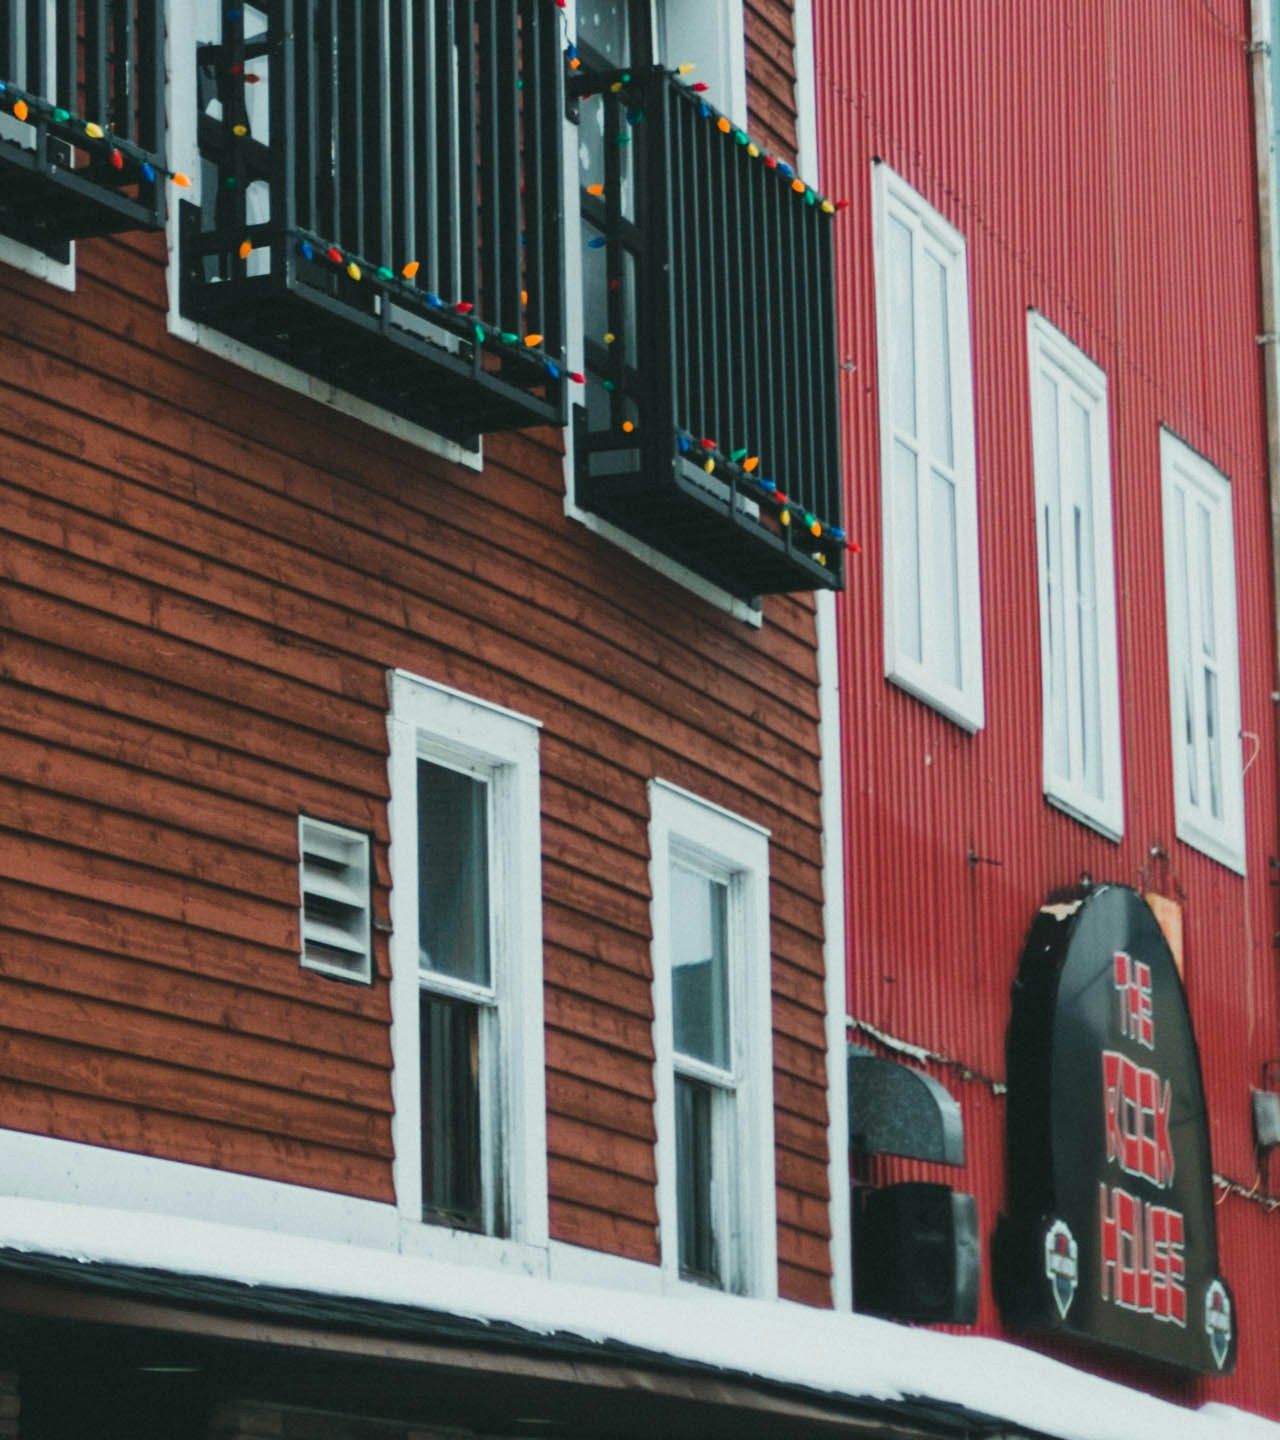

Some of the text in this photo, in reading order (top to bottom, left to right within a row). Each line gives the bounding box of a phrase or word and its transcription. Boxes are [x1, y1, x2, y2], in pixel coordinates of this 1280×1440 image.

[1114, 951, 1154, 1050] THE
[1102, 1050, 1173, 1187] ROCK
[1100, 1182, 1186, 1327] HOUSE
